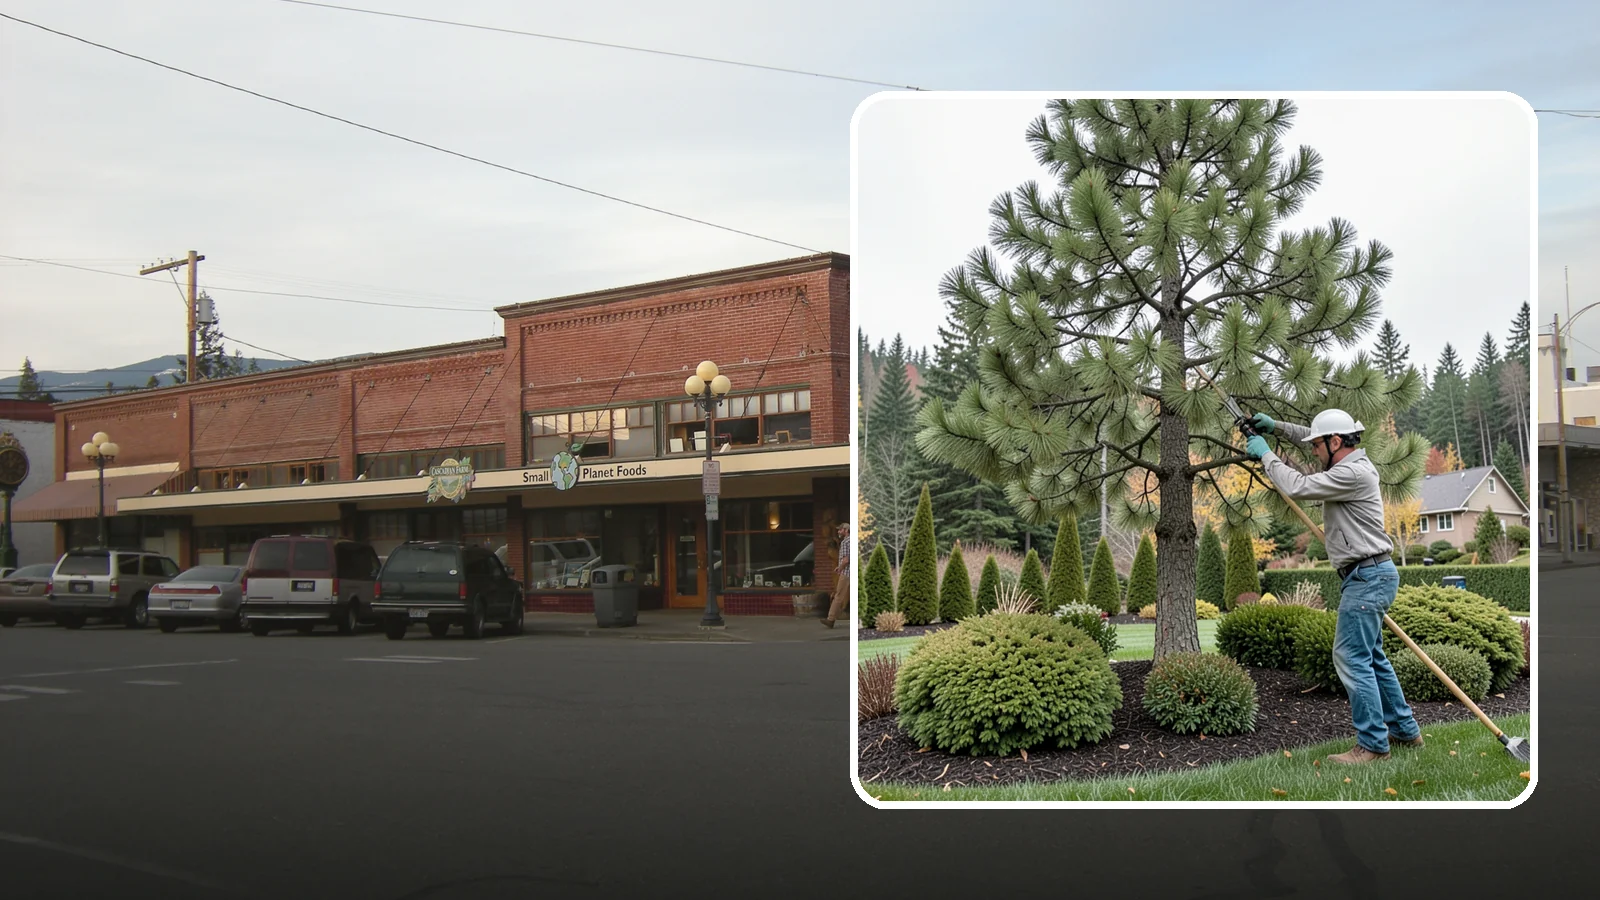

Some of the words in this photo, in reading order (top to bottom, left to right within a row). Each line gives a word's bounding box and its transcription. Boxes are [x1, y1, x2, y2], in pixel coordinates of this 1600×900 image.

[523, 471, 549, 483] Small
[582, 467, 614, 479] Planet
[616, 464, 647, 476] Foods
